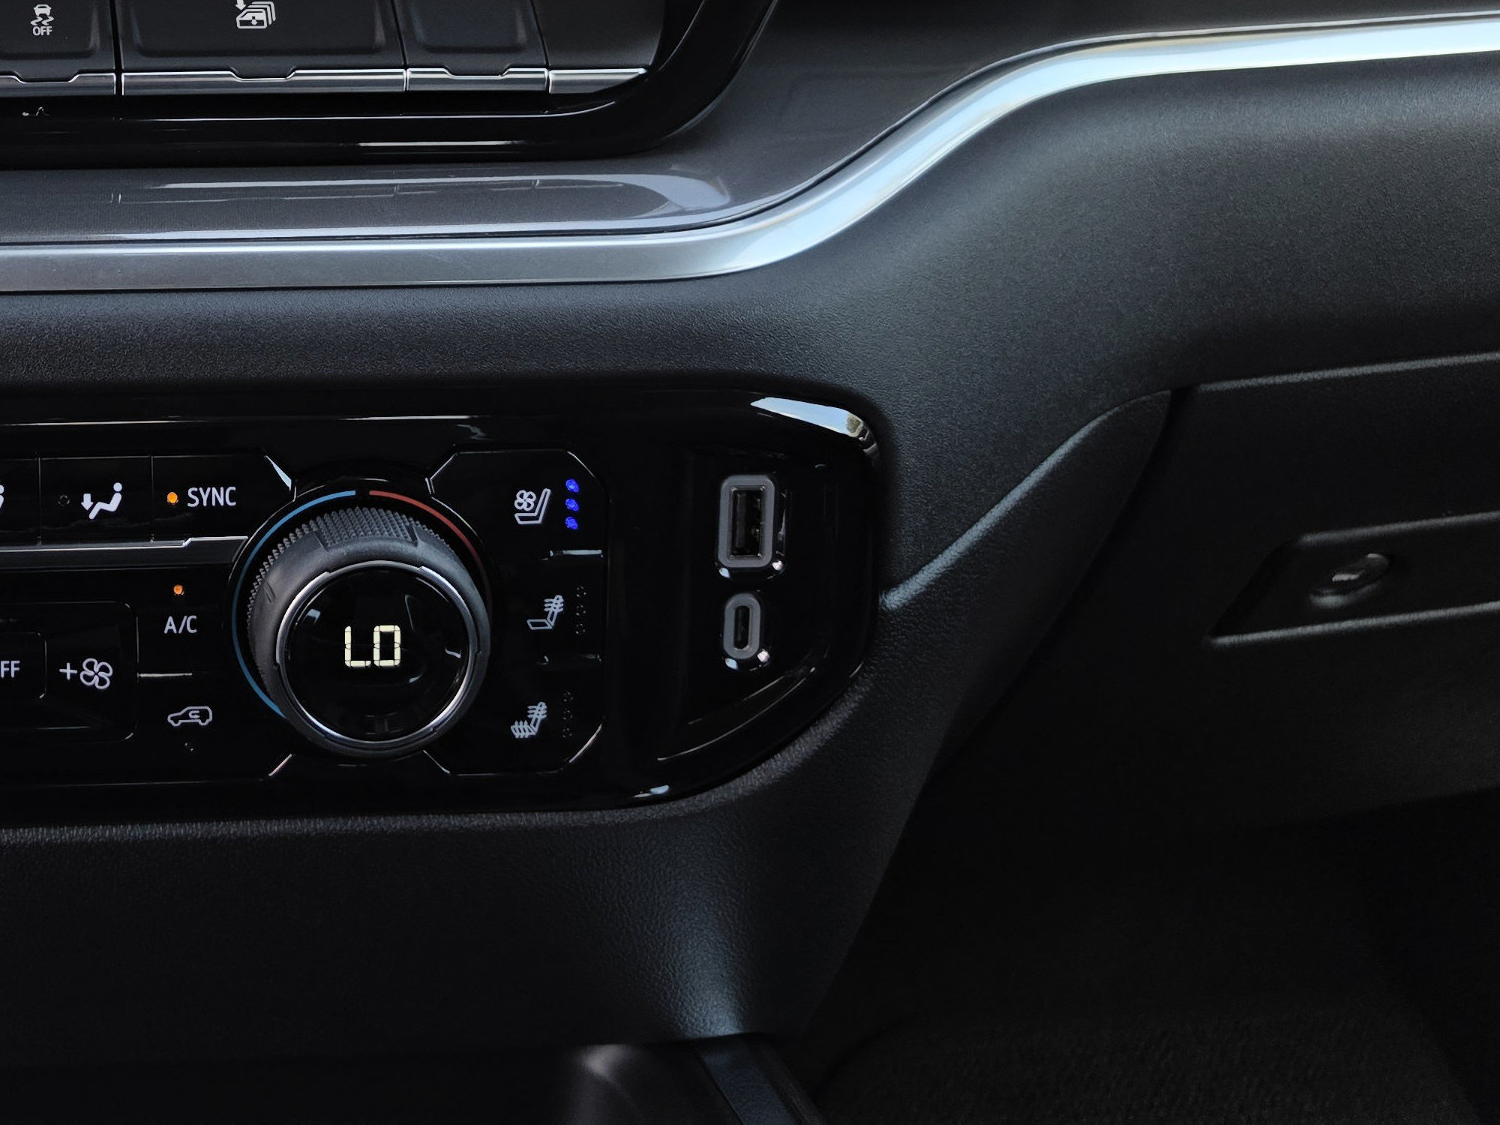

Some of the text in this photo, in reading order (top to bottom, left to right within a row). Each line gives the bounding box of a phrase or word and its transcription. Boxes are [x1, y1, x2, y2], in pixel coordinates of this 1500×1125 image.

[32, 25, 53, 36] OFF
[187, 486, 237, 509] SYNC
[163, 615, 198, 635] A/C
